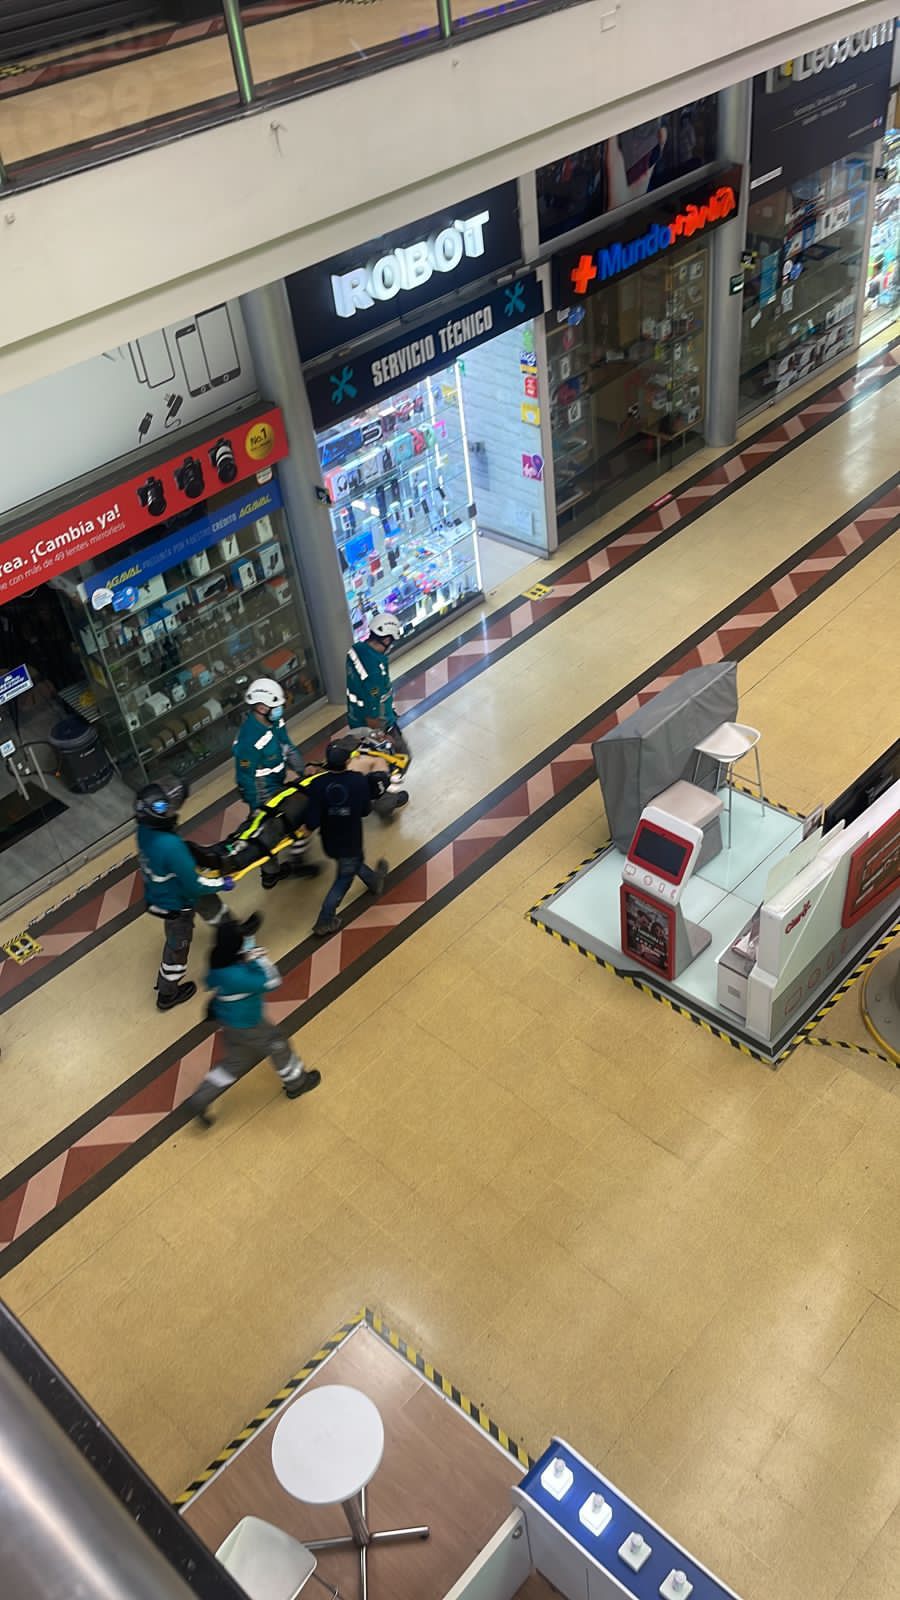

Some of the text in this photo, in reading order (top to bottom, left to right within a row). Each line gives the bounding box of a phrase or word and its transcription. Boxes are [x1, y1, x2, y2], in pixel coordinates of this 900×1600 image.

[331, 210, 490, 318] ROBOT
[371, 305, 493, 388] SERVICIO TÉCNICO
[96, 503, 121, 530] ya!
